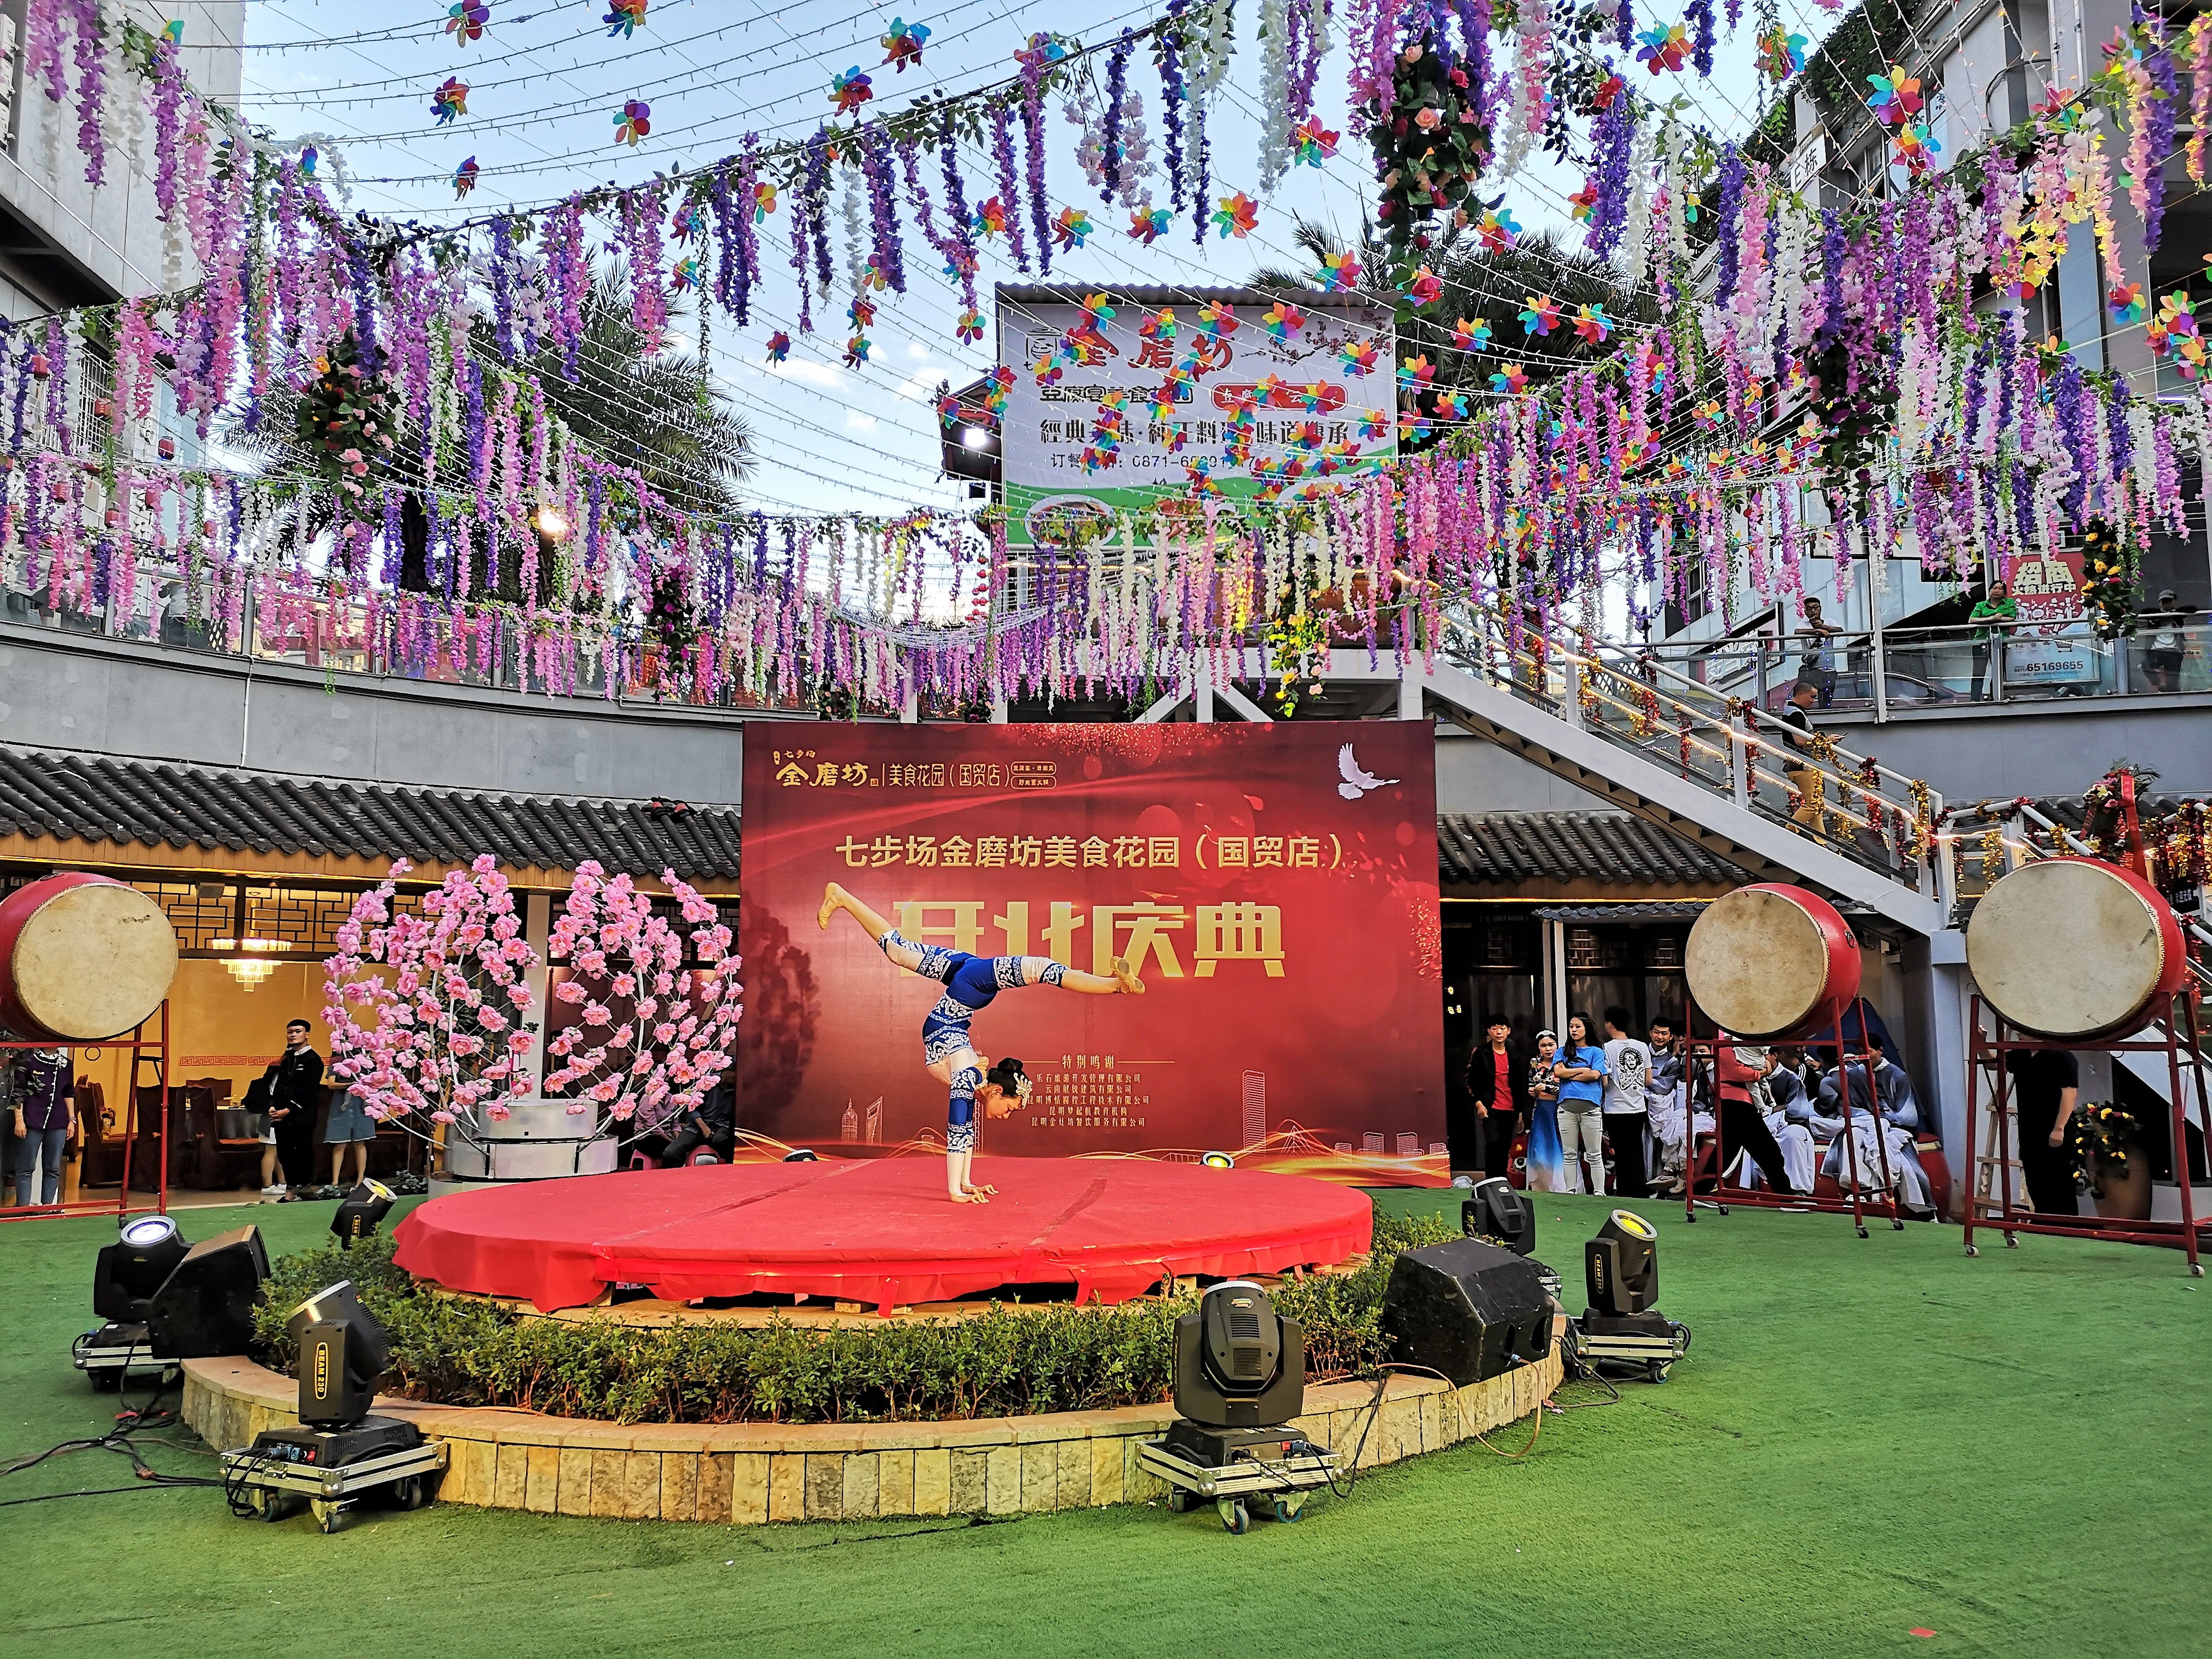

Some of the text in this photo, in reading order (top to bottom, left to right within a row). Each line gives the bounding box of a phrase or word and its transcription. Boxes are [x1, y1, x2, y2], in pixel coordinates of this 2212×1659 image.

[1040, 384, 1193, 404] 豆腐宴美食园
[2014, 561, 2074, 586] 招商
[2012, 582, 2077, 596] 火热进行中
[776, 762, 868, 786] 金磨坊
[836, 834, 1342, 869] 七步场金磨坊美食花园（国贸店）
[893, 901, 1285, 978] 开业庆典
[1062, 1054, 1114, 1070] 特别鸣谢
